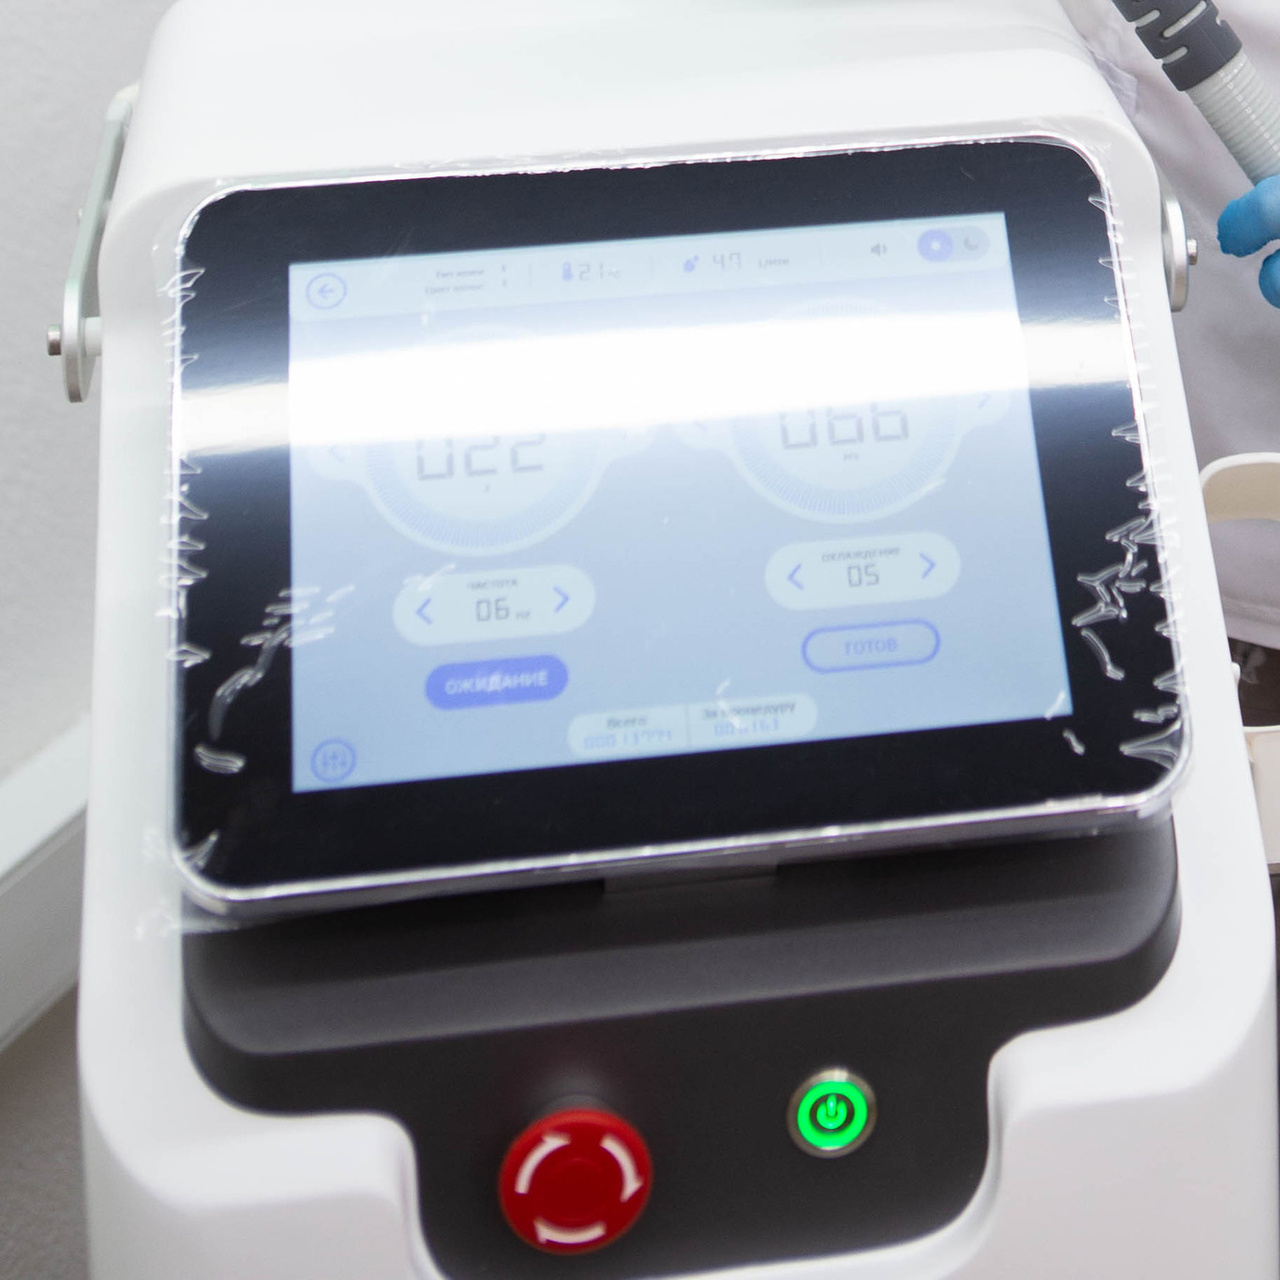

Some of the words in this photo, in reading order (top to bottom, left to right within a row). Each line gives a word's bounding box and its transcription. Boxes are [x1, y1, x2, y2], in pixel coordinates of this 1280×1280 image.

[846, 562, 880, 588] 05
[475, 596, 510, 622] 06
[844, 636, 898, 656] ГОТОВ
[444, 669, 549, 696] ОЖИДАНИЕ
